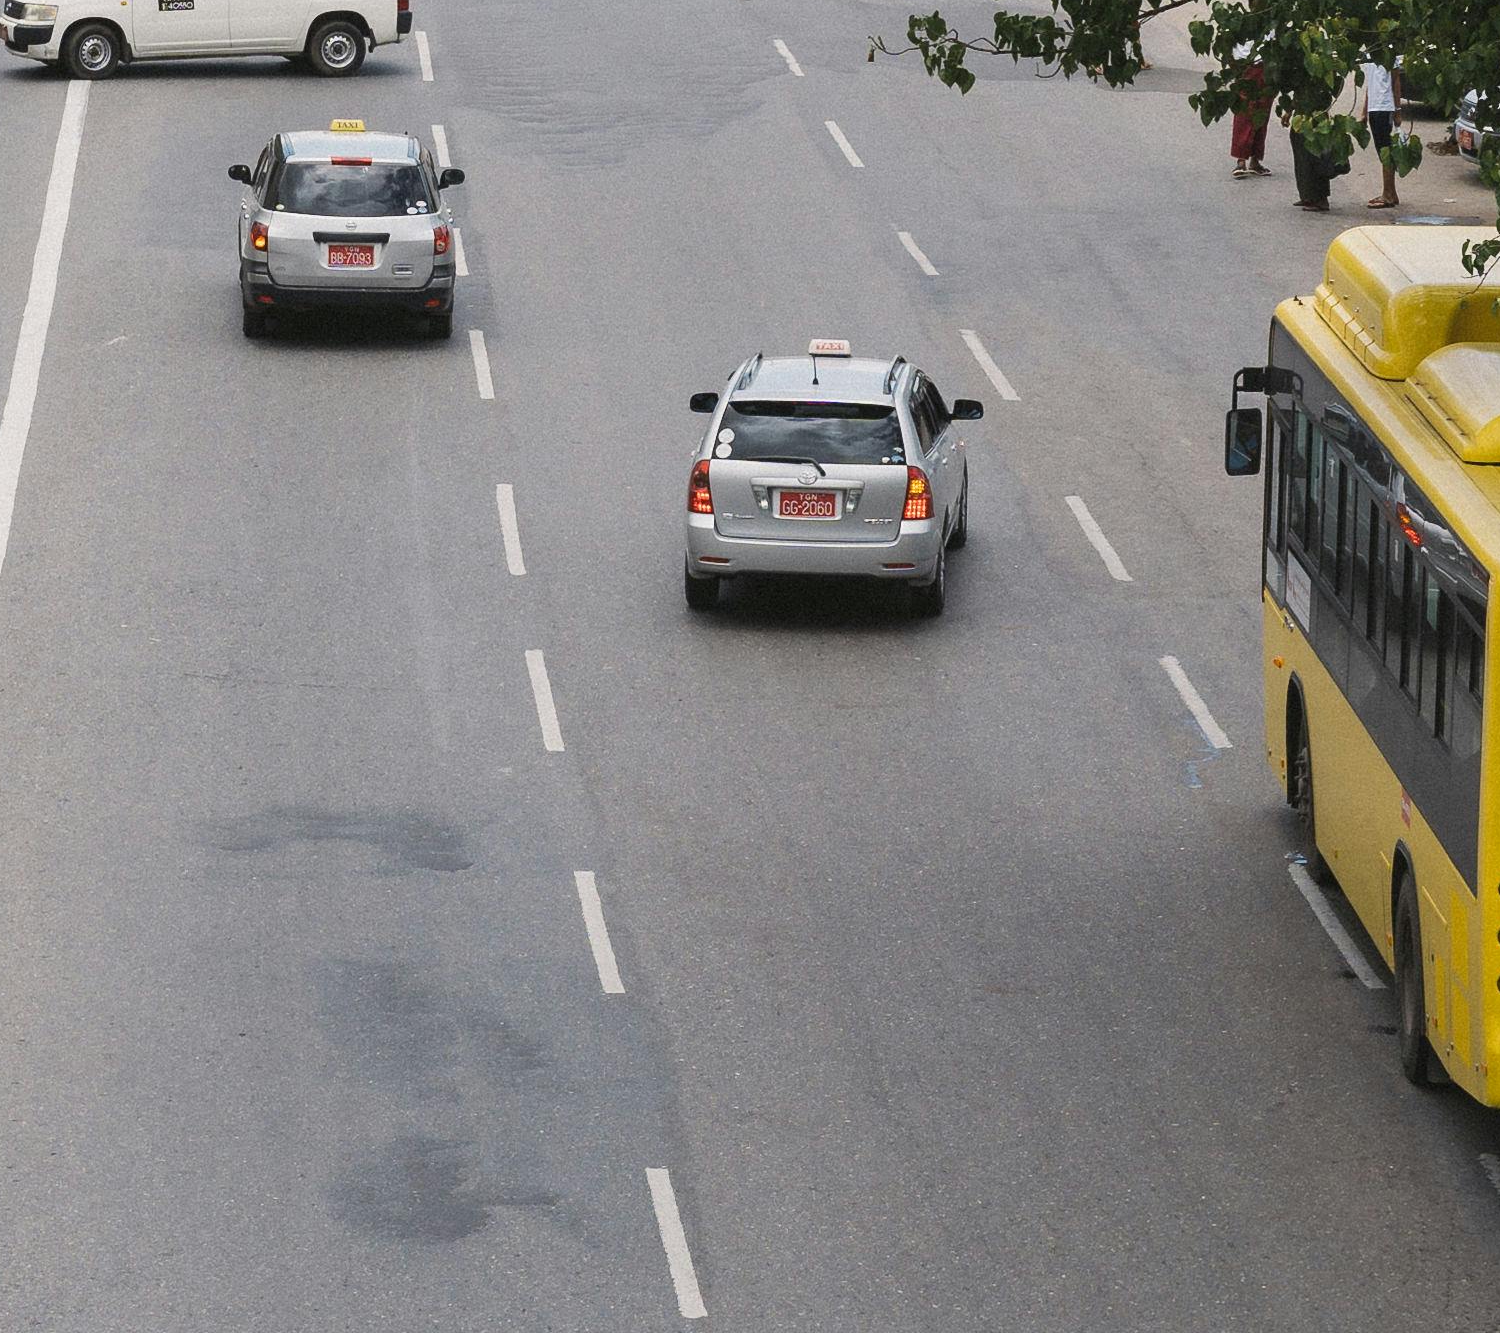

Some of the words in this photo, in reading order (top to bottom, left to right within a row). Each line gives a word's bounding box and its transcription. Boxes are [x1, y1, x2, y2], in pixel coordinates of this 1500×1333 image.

[338, 121, 359, 129] TAXI
[330, 252, 372, 265] BB-7093
[815, 342, 845, 351] TAXI
[799, 492, 818, 501] YGN
[782, 500, 833, 516] GG-2060
